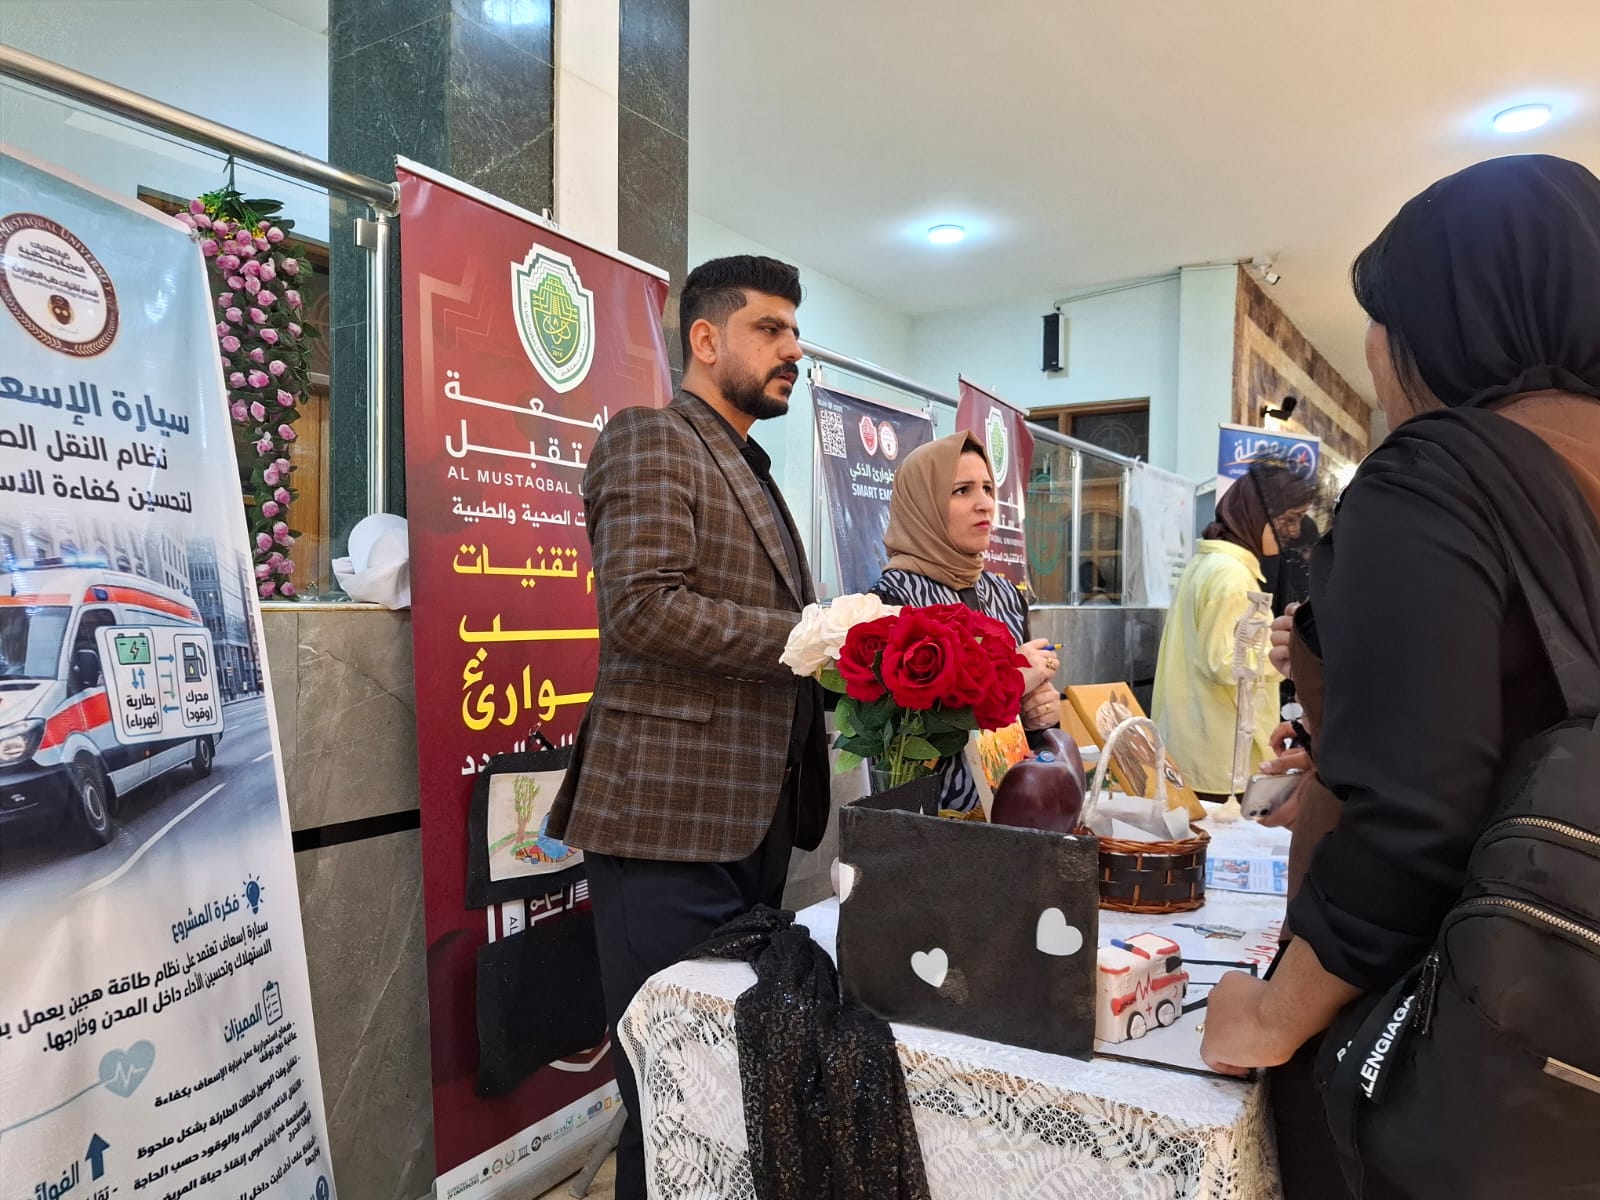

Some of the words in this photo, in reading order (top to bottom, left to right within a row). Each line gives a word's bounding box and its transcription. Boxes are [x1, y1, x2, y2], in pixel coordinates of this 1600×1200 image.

[0, 376, 102, 426] الإسع
[112, 389, 190, 438] سيارة
[444, 370, 609, 431] امعة
[0, 423, 37, 452] الص
[47, 430, 108, 462] النقل
[117, 442, 168, 471] نظام
[0, 468, 45, 496] الاس
[448, 465, 470, 481] AL
[477, 469, 573, 495] MUSTAQBAL
[849, 462, 872, 481] الذكي
[53, 473, 120, 503] كفاءة
[128, 486, 193, 514] لتحسين
[851, 483, 878, 499] SMART
[452, 496, 516, 525] والطبية
[521, 503, 571, 528] الصحية
[453, 543, 578, 588] تقنيات
[126, 693, 156, 710] بطارية
[185, 689, 209, 704] محرك
[126, 711, 160, 730] (كهرباء)
[186, 705, 213, 723] (وقود)
[214, 893, 240, 922] فكرة
[171, 902, 212, 944] المشروع
[247, 921, 269, 941] سيارة
[197, 940, 218, 963] تعتمد
[219, 926, 247, 952] إسعاف
[182, 952, 197, 975] على
[234, 938, 272, 969] الاستهلاك
[108, 971, 151, 996] طاقة
[154, 959, 181, 988] نظام
[184, 971, 204, 997] الأداء
[204, 959, 233, 989] وتحسين
[69, 988, 103, 1016] هجين
[101, 996, 148, 1030] المدن
[153, 989, 182, 1014] داخل
[18, 1008, 65, 1034] يعمل
[224, 1002, 263, 1043] المميزات
[43, 1018, 97, 1052] وخارجها.
[193, 1065, 228, 1092] الإسعاف
[154, 1086, 192, 1108] بكفاءة
[209, 1102, 238, 1126] الطارئة
[176, 1121, 208, 1144] بشكل
[201, 1131, 240, 1158] والوقود
[137, 1136, 175, 1159] ملحوظ
[171, 1153, 199, 1172] حسب
[224, 1153, 246, 1174] إنقاذ
[134, 1165, 168, 1191] الحاجة
[200, 1167, 223, 1186] حياة
[249, 1182, 270, 1200] داخل
